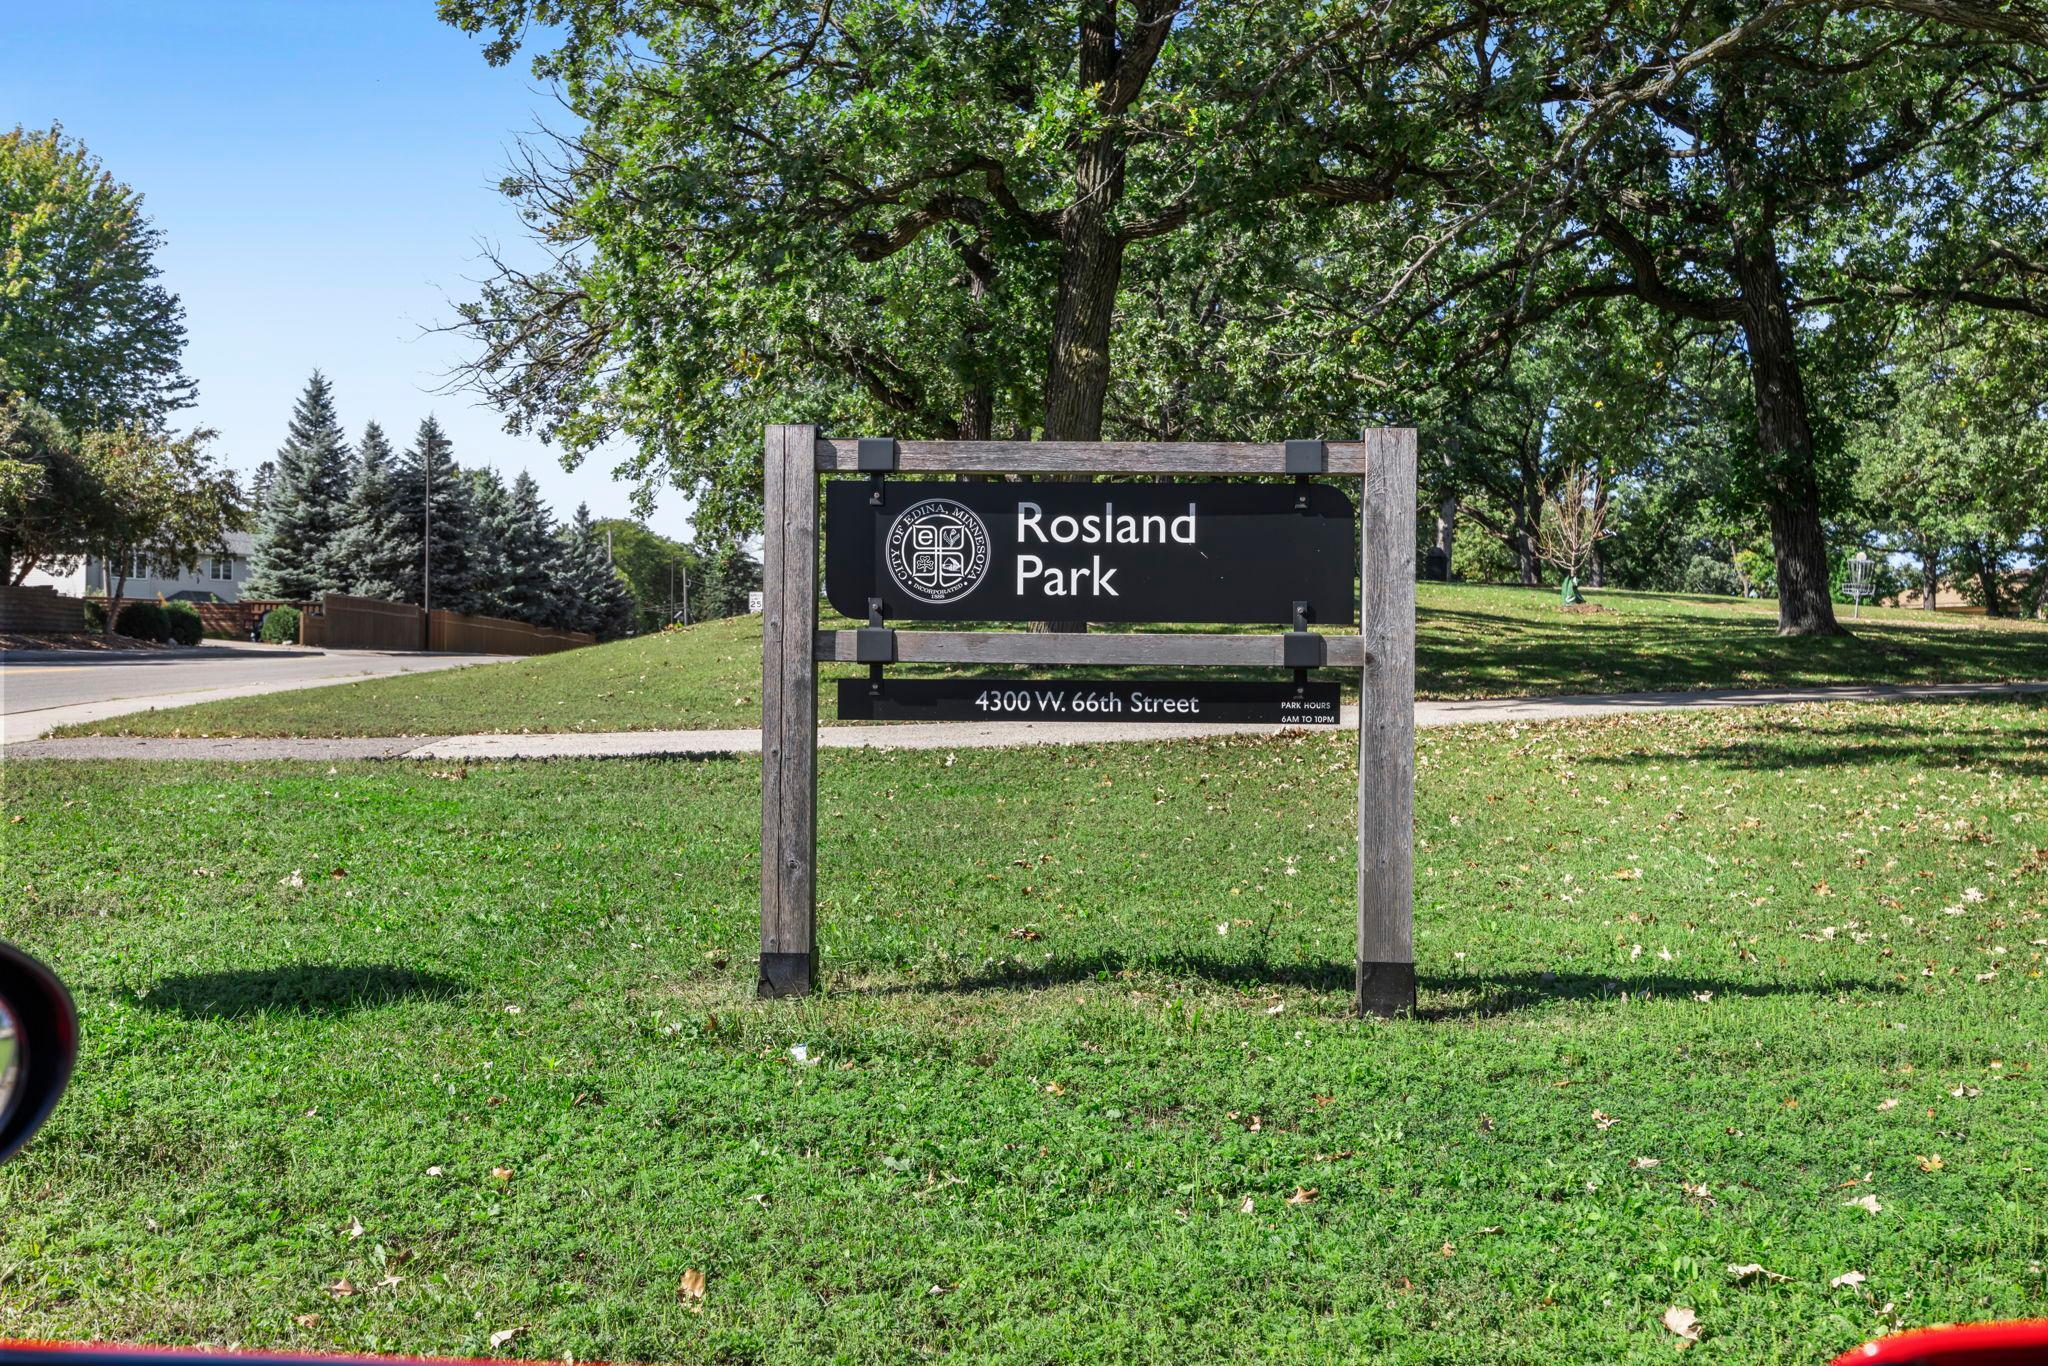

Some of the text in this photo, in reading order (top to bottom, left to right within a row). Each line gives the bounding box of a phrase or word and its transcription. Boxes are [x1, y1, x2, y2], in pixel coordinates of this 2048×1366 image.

[1017, 501, 1196, 544] Rosland
[890, 503, 986, 580] CITY OF EDINA, MINNESOTA
[1016, 554, 1120, 596] Park
[913, 583, 964, 595] INCORPORATED
[750, 600, 762, 608] 25
[974, 690, 1200, 713] 4300 W. 66th Street
[1281, 701, 1302, 709] PARK
[1281, 715, 1335, 723] 6AM TO 10PM
